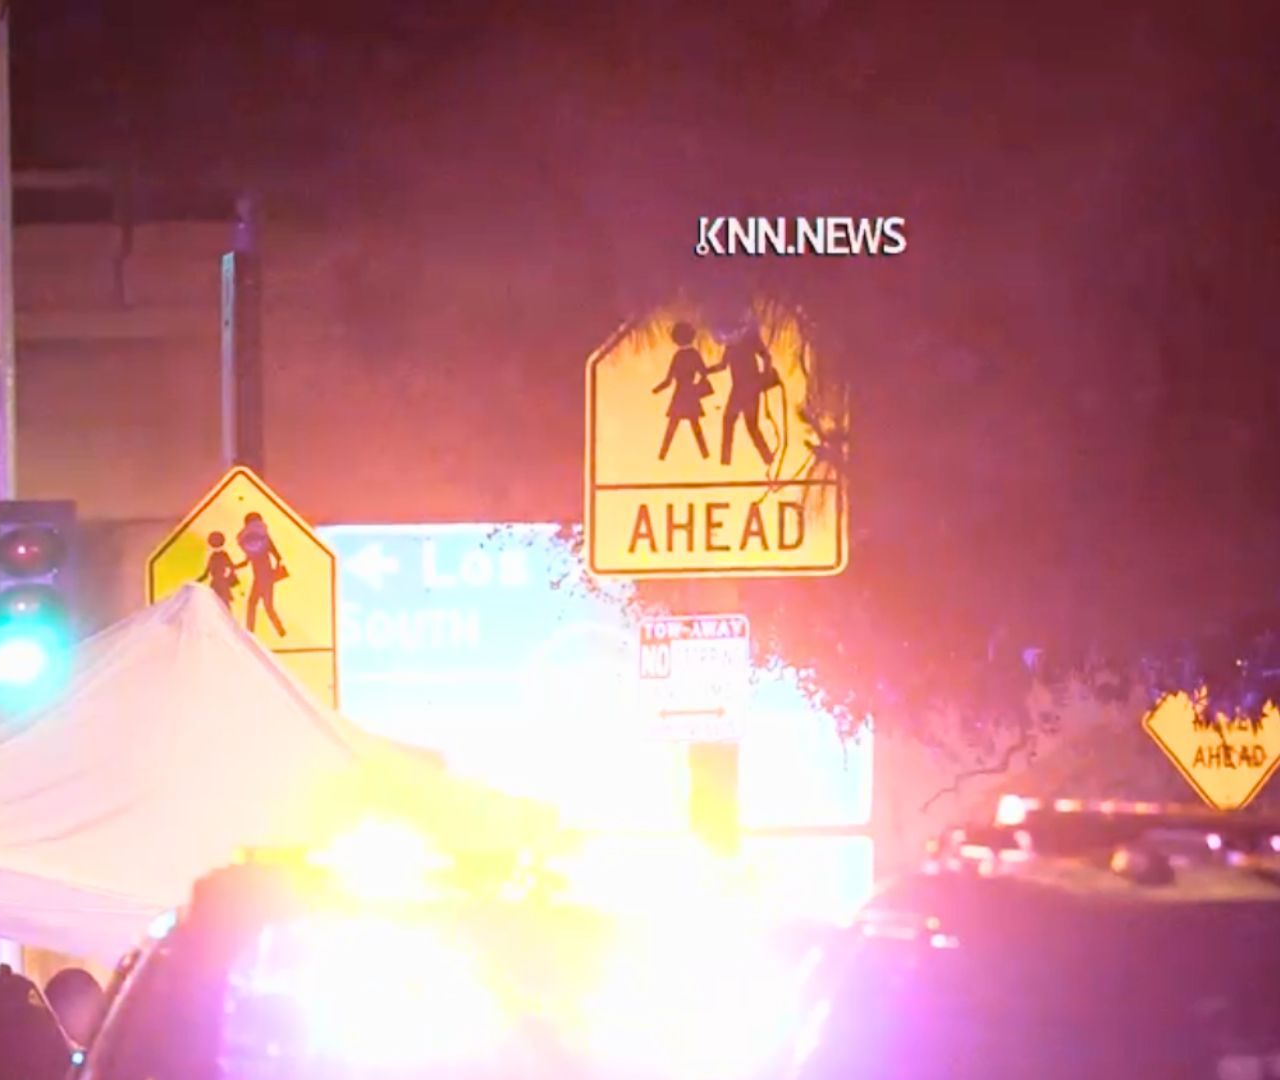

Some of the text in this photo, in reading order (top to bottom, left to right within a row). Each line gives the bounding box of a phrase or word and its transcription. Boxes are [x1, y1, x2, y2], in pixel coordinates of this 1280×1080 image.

[628, 502, 806, 554] AHEAD
[342, 601, 480, 650] SOUTH
[644, 620, 743, 639] TOW-AWAY
[641, 644, 670, 677] NO
[1192, 744, 1268, 770] AHEAD
